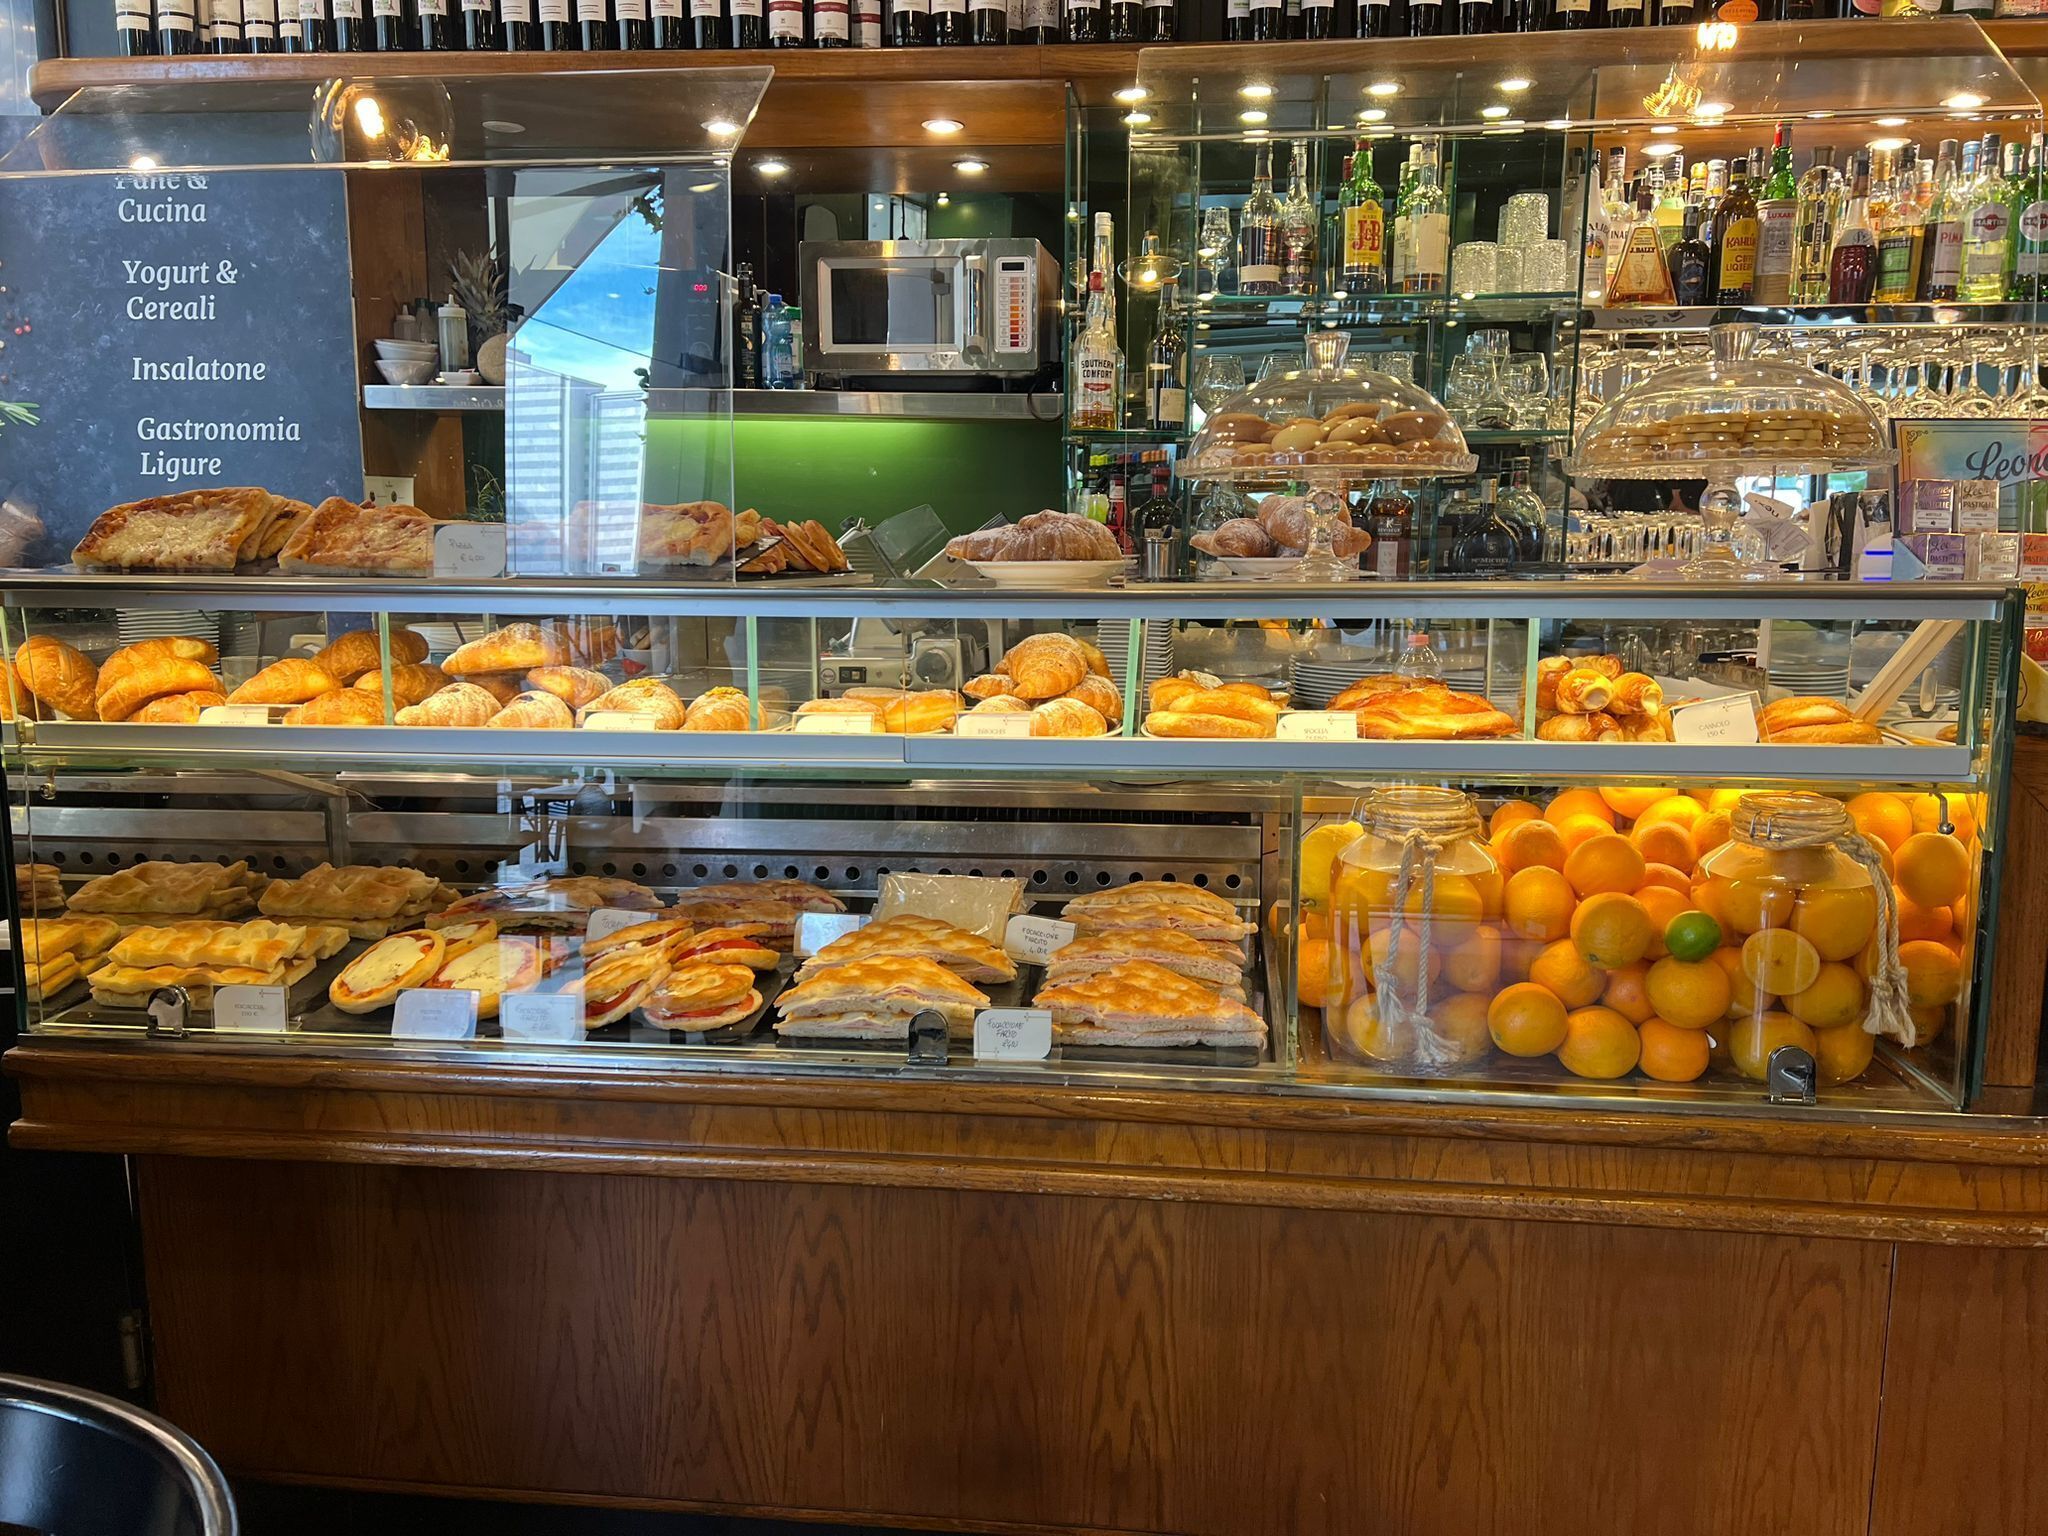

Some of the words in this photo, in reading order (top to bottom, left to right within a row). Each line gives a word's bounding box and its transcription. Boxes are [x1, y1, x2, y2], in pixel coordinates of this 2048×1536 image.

[118, 196, 207, 223] Cucina
[122, 260, 210, 291] Yogurt
[215, 259, 239, 284] &
[126, 294, 216, 321] Cereali
[131, 355, 267, 381] Insalatone
[1080, 359, 1115, 369] SOUTHERN
[1082, 369, 1113, 379] COMFORT
[137, 416, 301, 441] Gastronomia
[140, 450, 222, 481] Ligure
